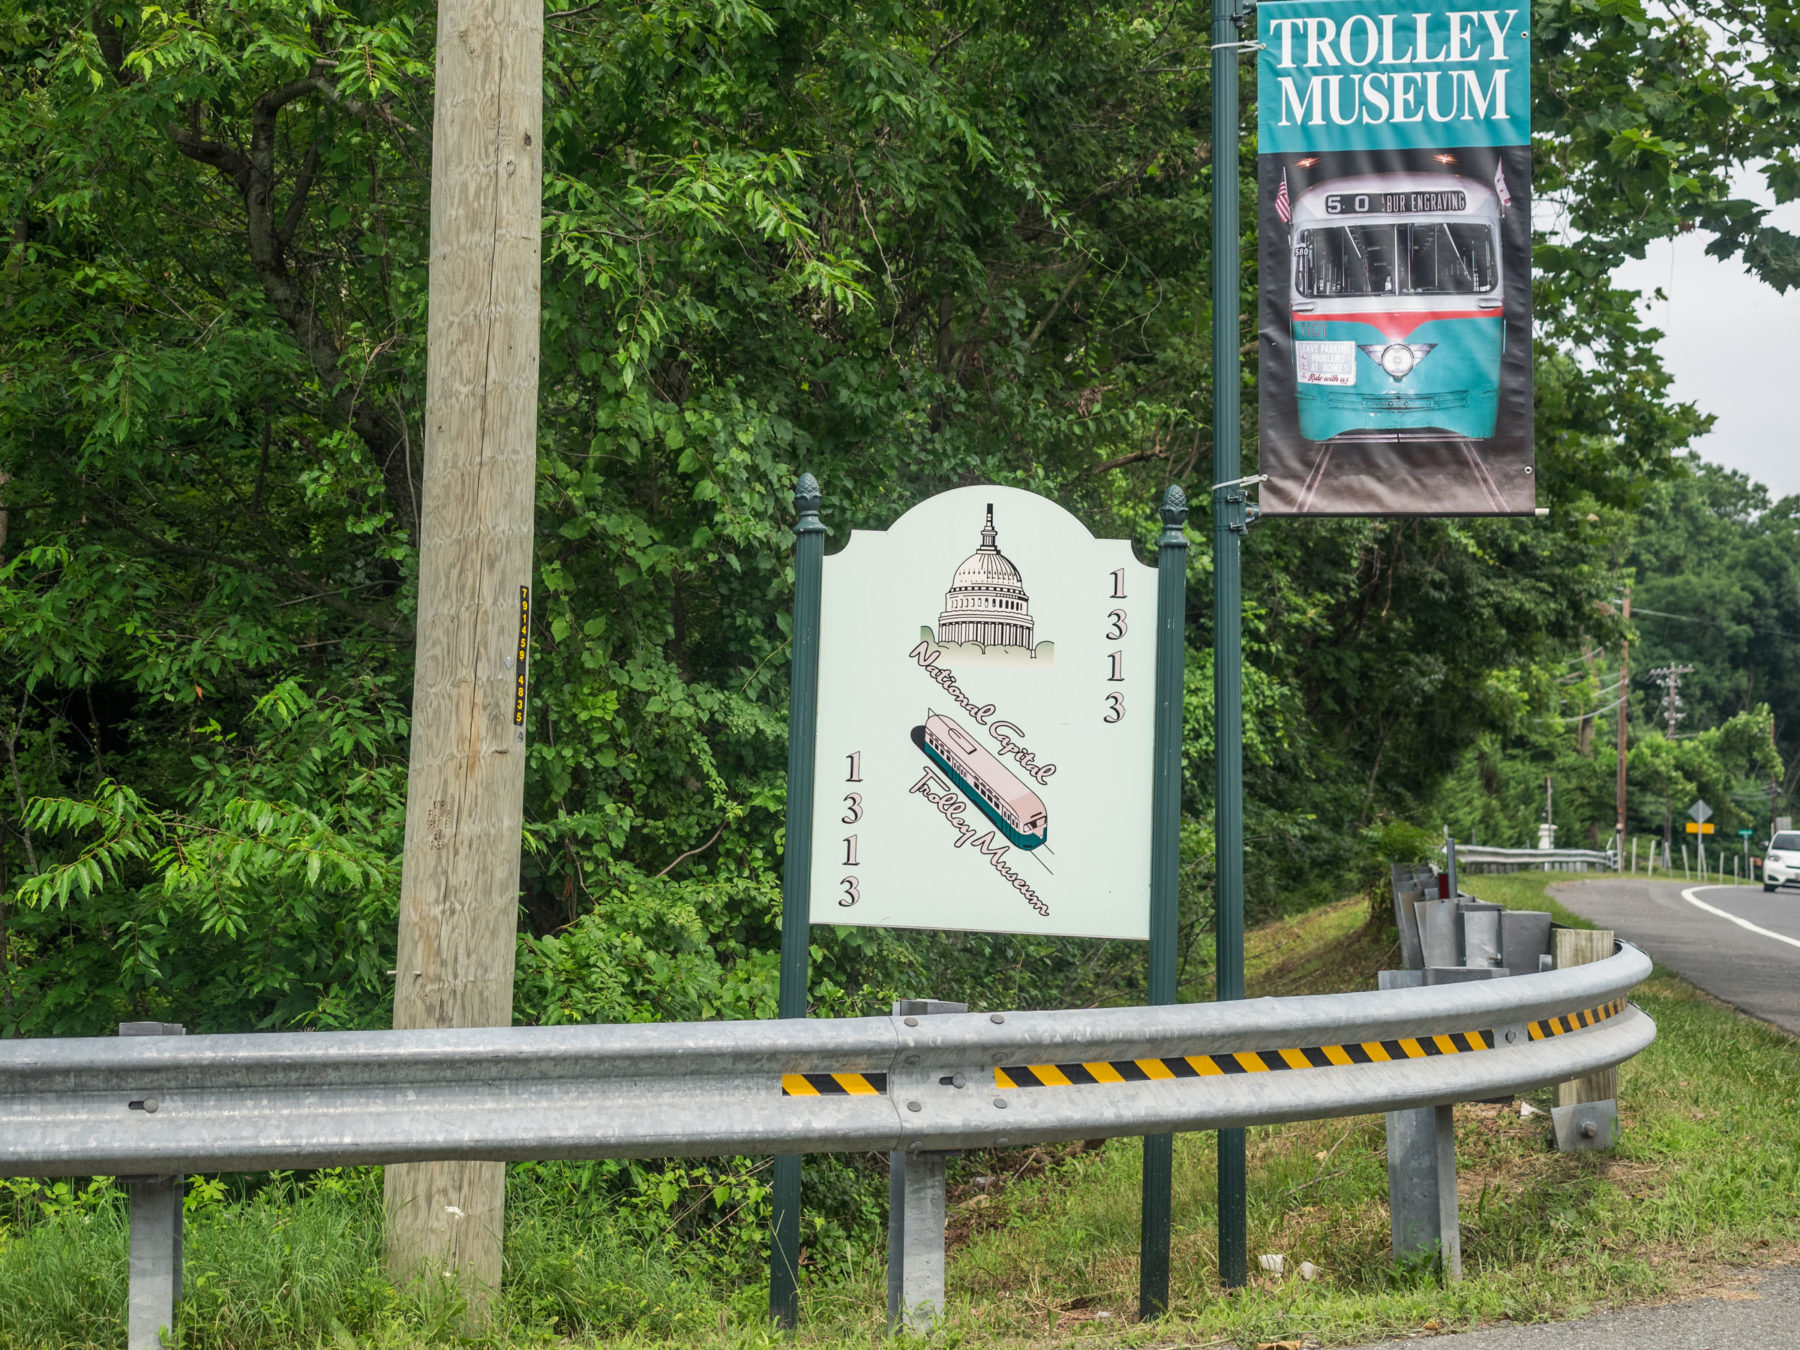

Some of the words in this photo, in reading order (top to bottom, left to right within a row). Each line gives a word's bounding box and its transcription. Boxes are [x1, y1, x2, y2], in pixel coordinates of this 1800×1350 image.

[1270, 9, 1518, 68] TROLLEY
[1277, 69, 1511, 126] MUSEUM
[1412, 192, 1465, 211] ENGRAVING
[1302, 321, 1327, 338] 1101
[1308, 372, 1323, 383] Ride
[1324, 374, 1339, 383] with
[1103, 567, 1128, 724] 1313
[909, 640, 996, 726] National
[988, 720, 1057, 786] Capital
[838, 750, 864, 907] 1313
[909, 766, 977, 849] Trolley
[971, 830, 1050, 917] Museum
